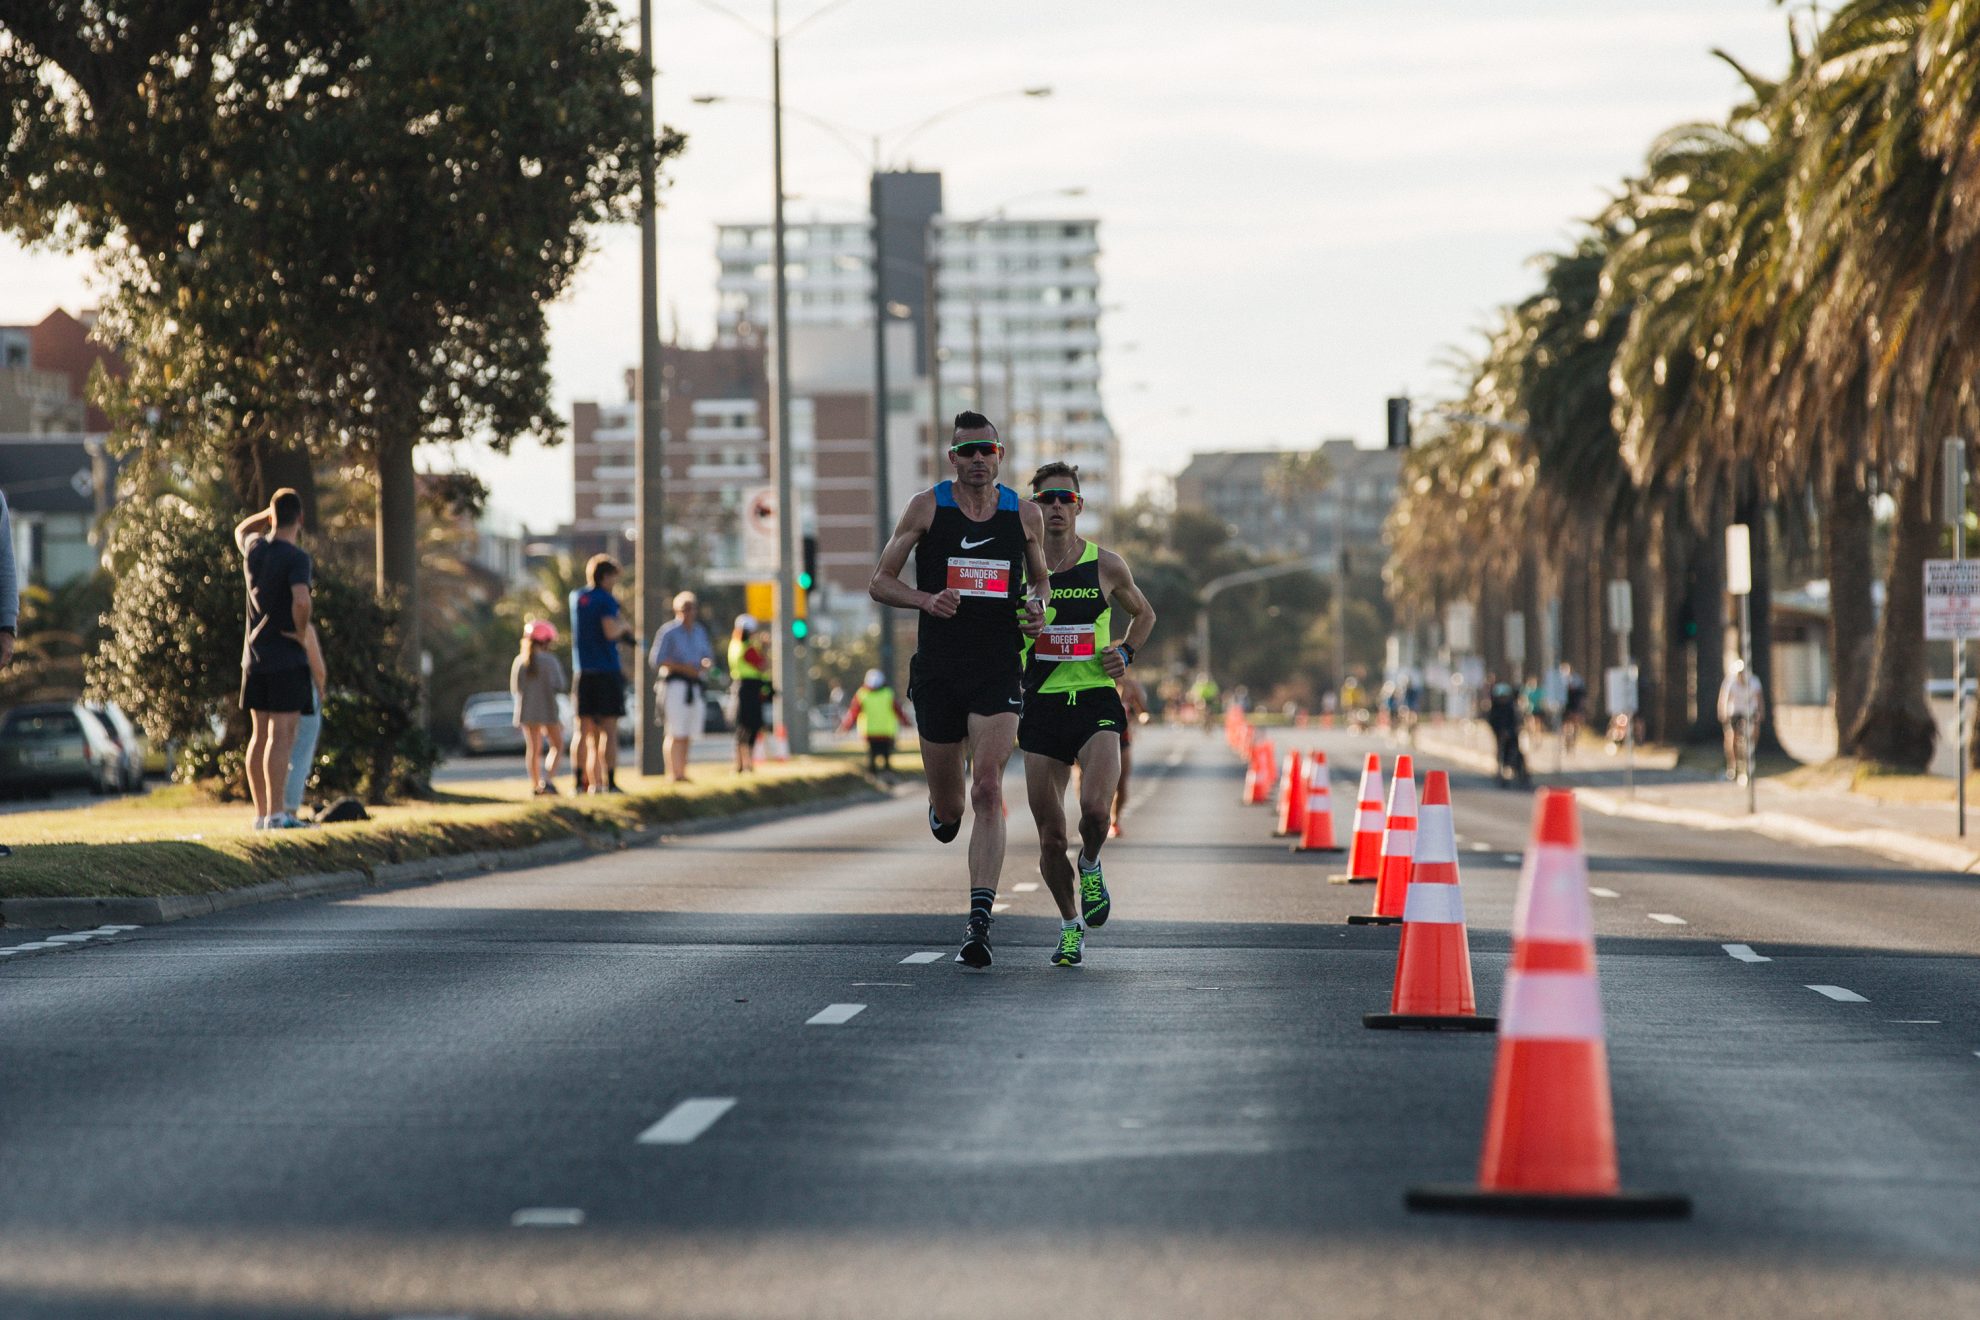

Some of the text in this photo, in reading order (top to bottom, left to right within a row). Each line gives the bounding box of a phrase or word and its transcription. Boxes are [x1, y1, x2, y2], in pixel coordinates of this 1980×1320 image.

[960, 568, 998, 580] SAUNDERS
[975, 579, 983, 589] 15
[1050, 634, 1079, 645] ROEGER
[1061, 644, 1070, 654] 14
